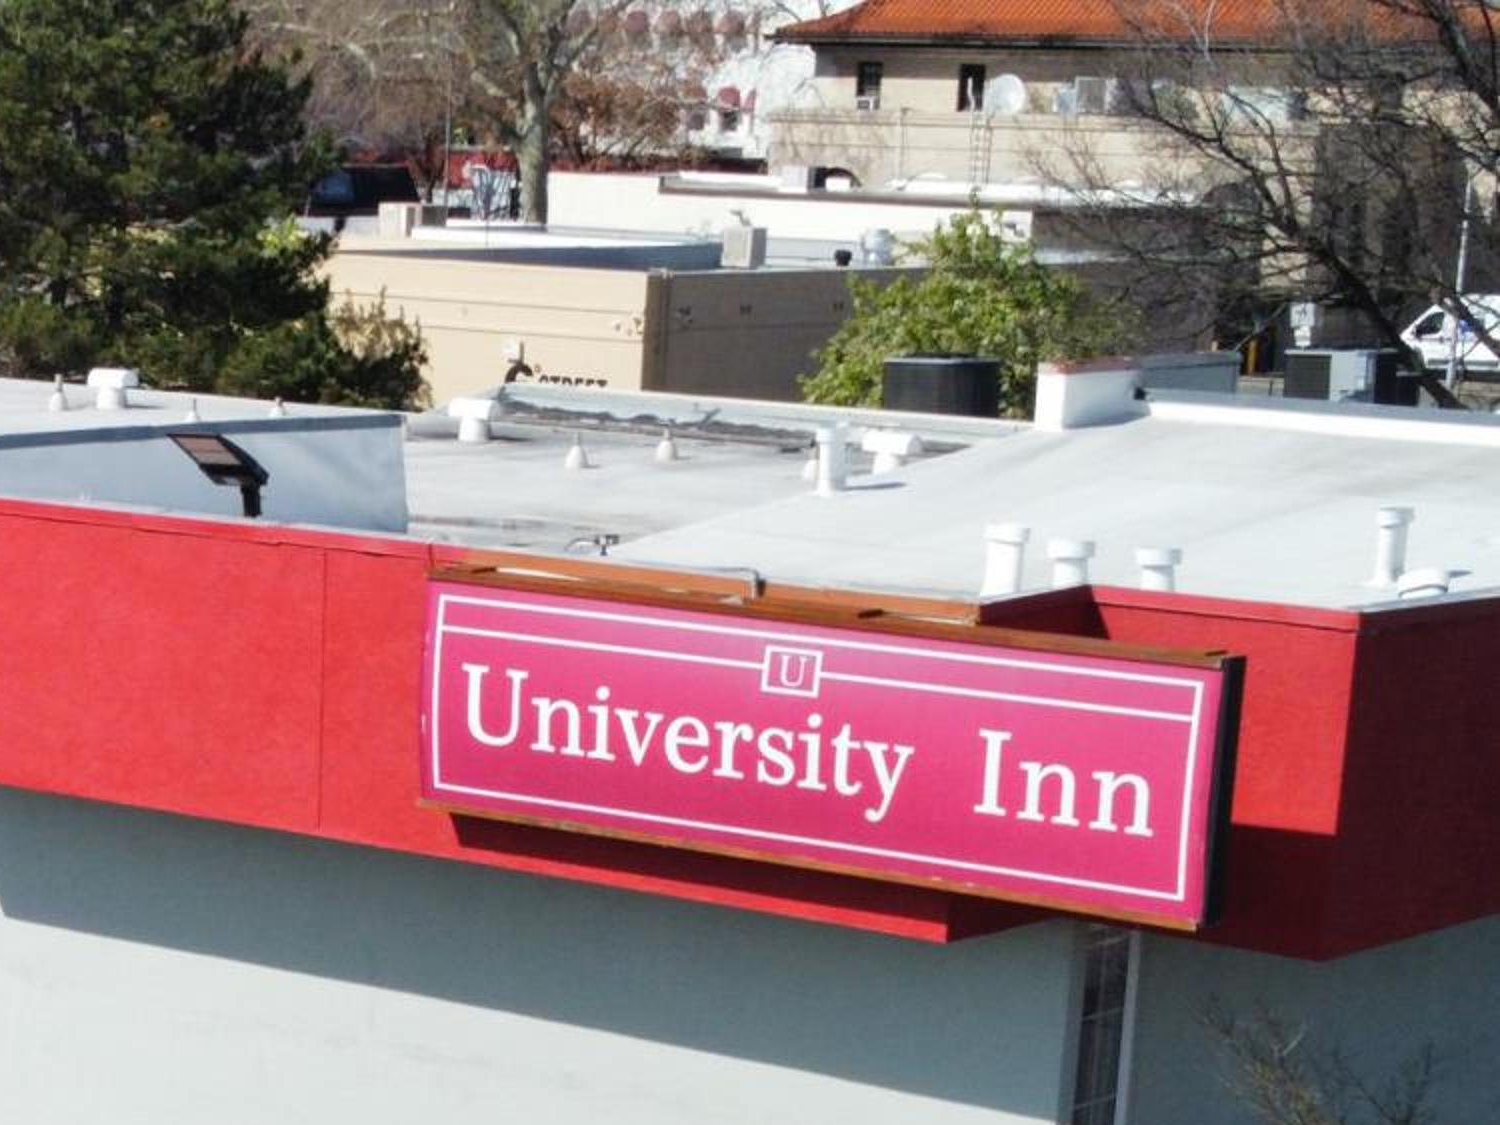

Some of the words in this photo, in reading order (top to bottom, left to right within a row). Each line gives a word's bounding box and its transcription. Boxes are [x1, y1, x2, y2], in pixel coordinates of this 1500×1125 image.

[780, 655, 807, 687] U
[461, 662, 915, 823] University
[973, 727, 1154, 837] Inn
